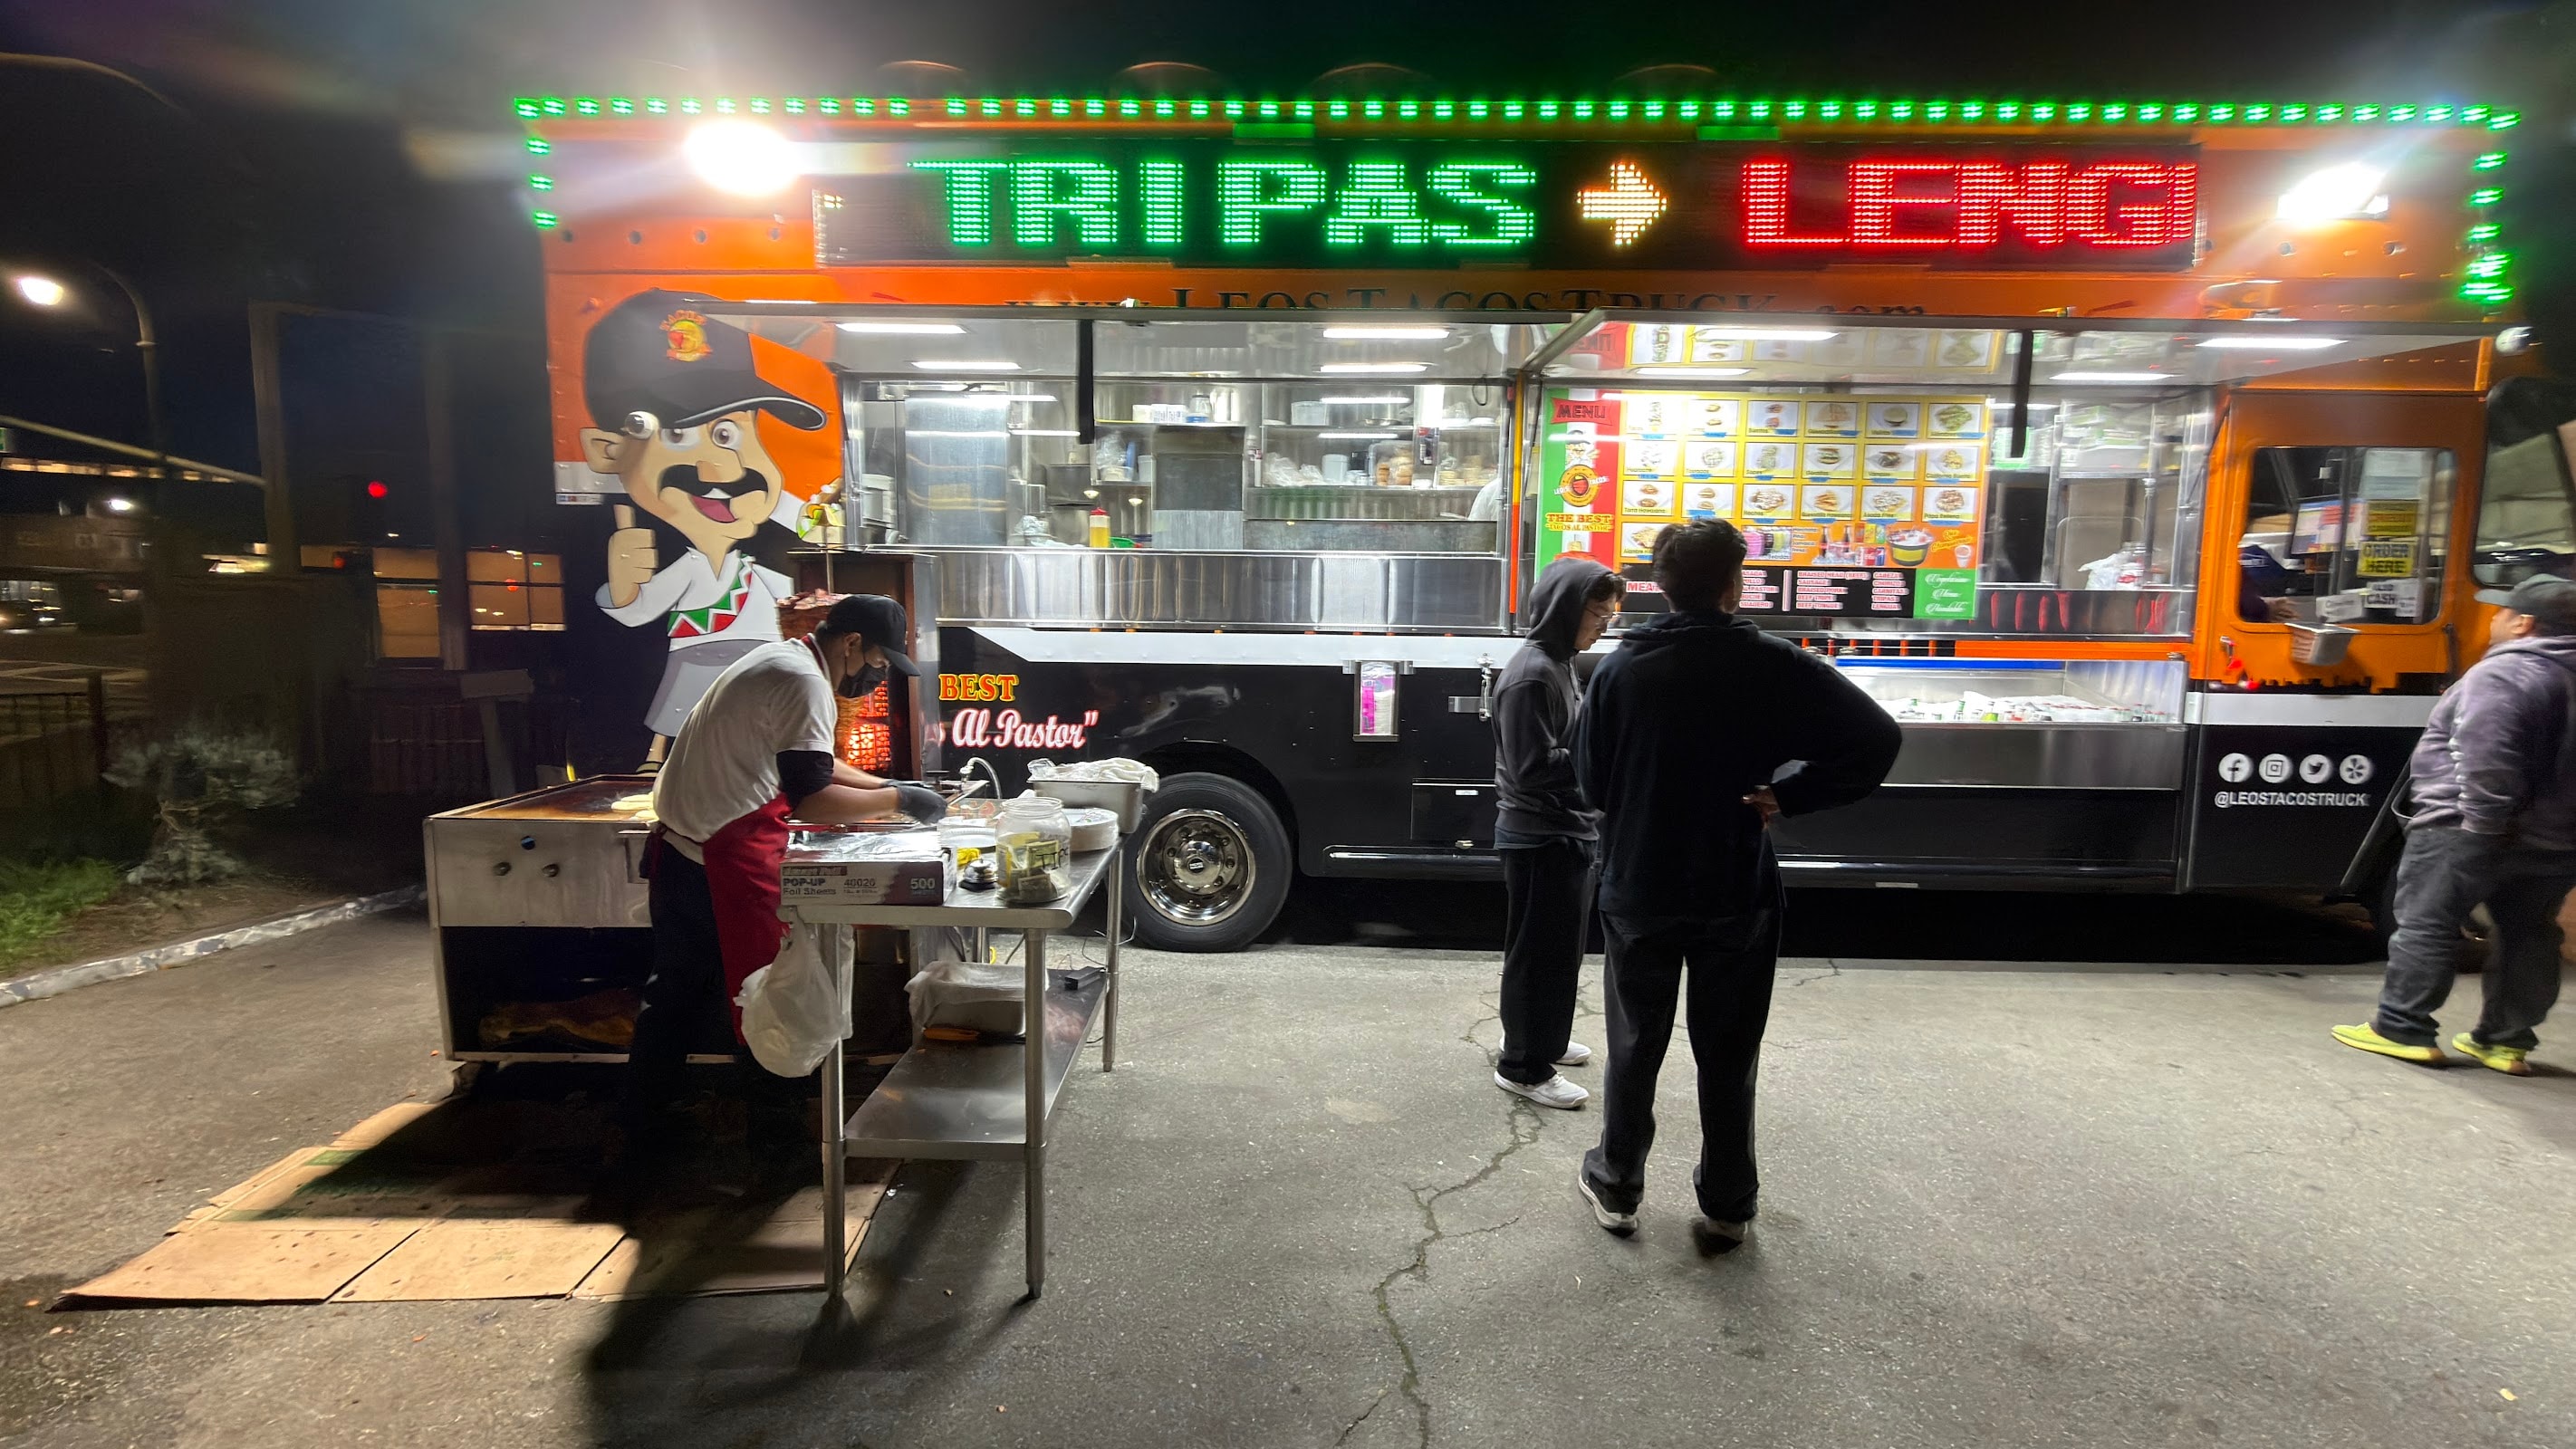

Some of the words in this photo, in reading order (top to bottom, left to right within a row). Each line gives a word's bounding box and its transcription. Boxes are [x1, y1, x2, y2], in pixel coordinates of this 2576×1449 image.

[908, 160, 1538, 246] TRIPAS
[1741, 160, 2196, 247] LENG
[1556, 404, 1607, 419] MENU
[1547, 513, 1574, 523] THE
[1577, 514, 1611, 523] BEST
[2364, 559, 2407, 573] HERE
[938, 674, 1020, 701] BEST
[2214, 791, 2370, 809] @LEOSTACOSTRUCK
[783, 878, 826, 887] POP-UP
[910, 878, 937, 890] 500
[783, 888, 802, 896] Foil
